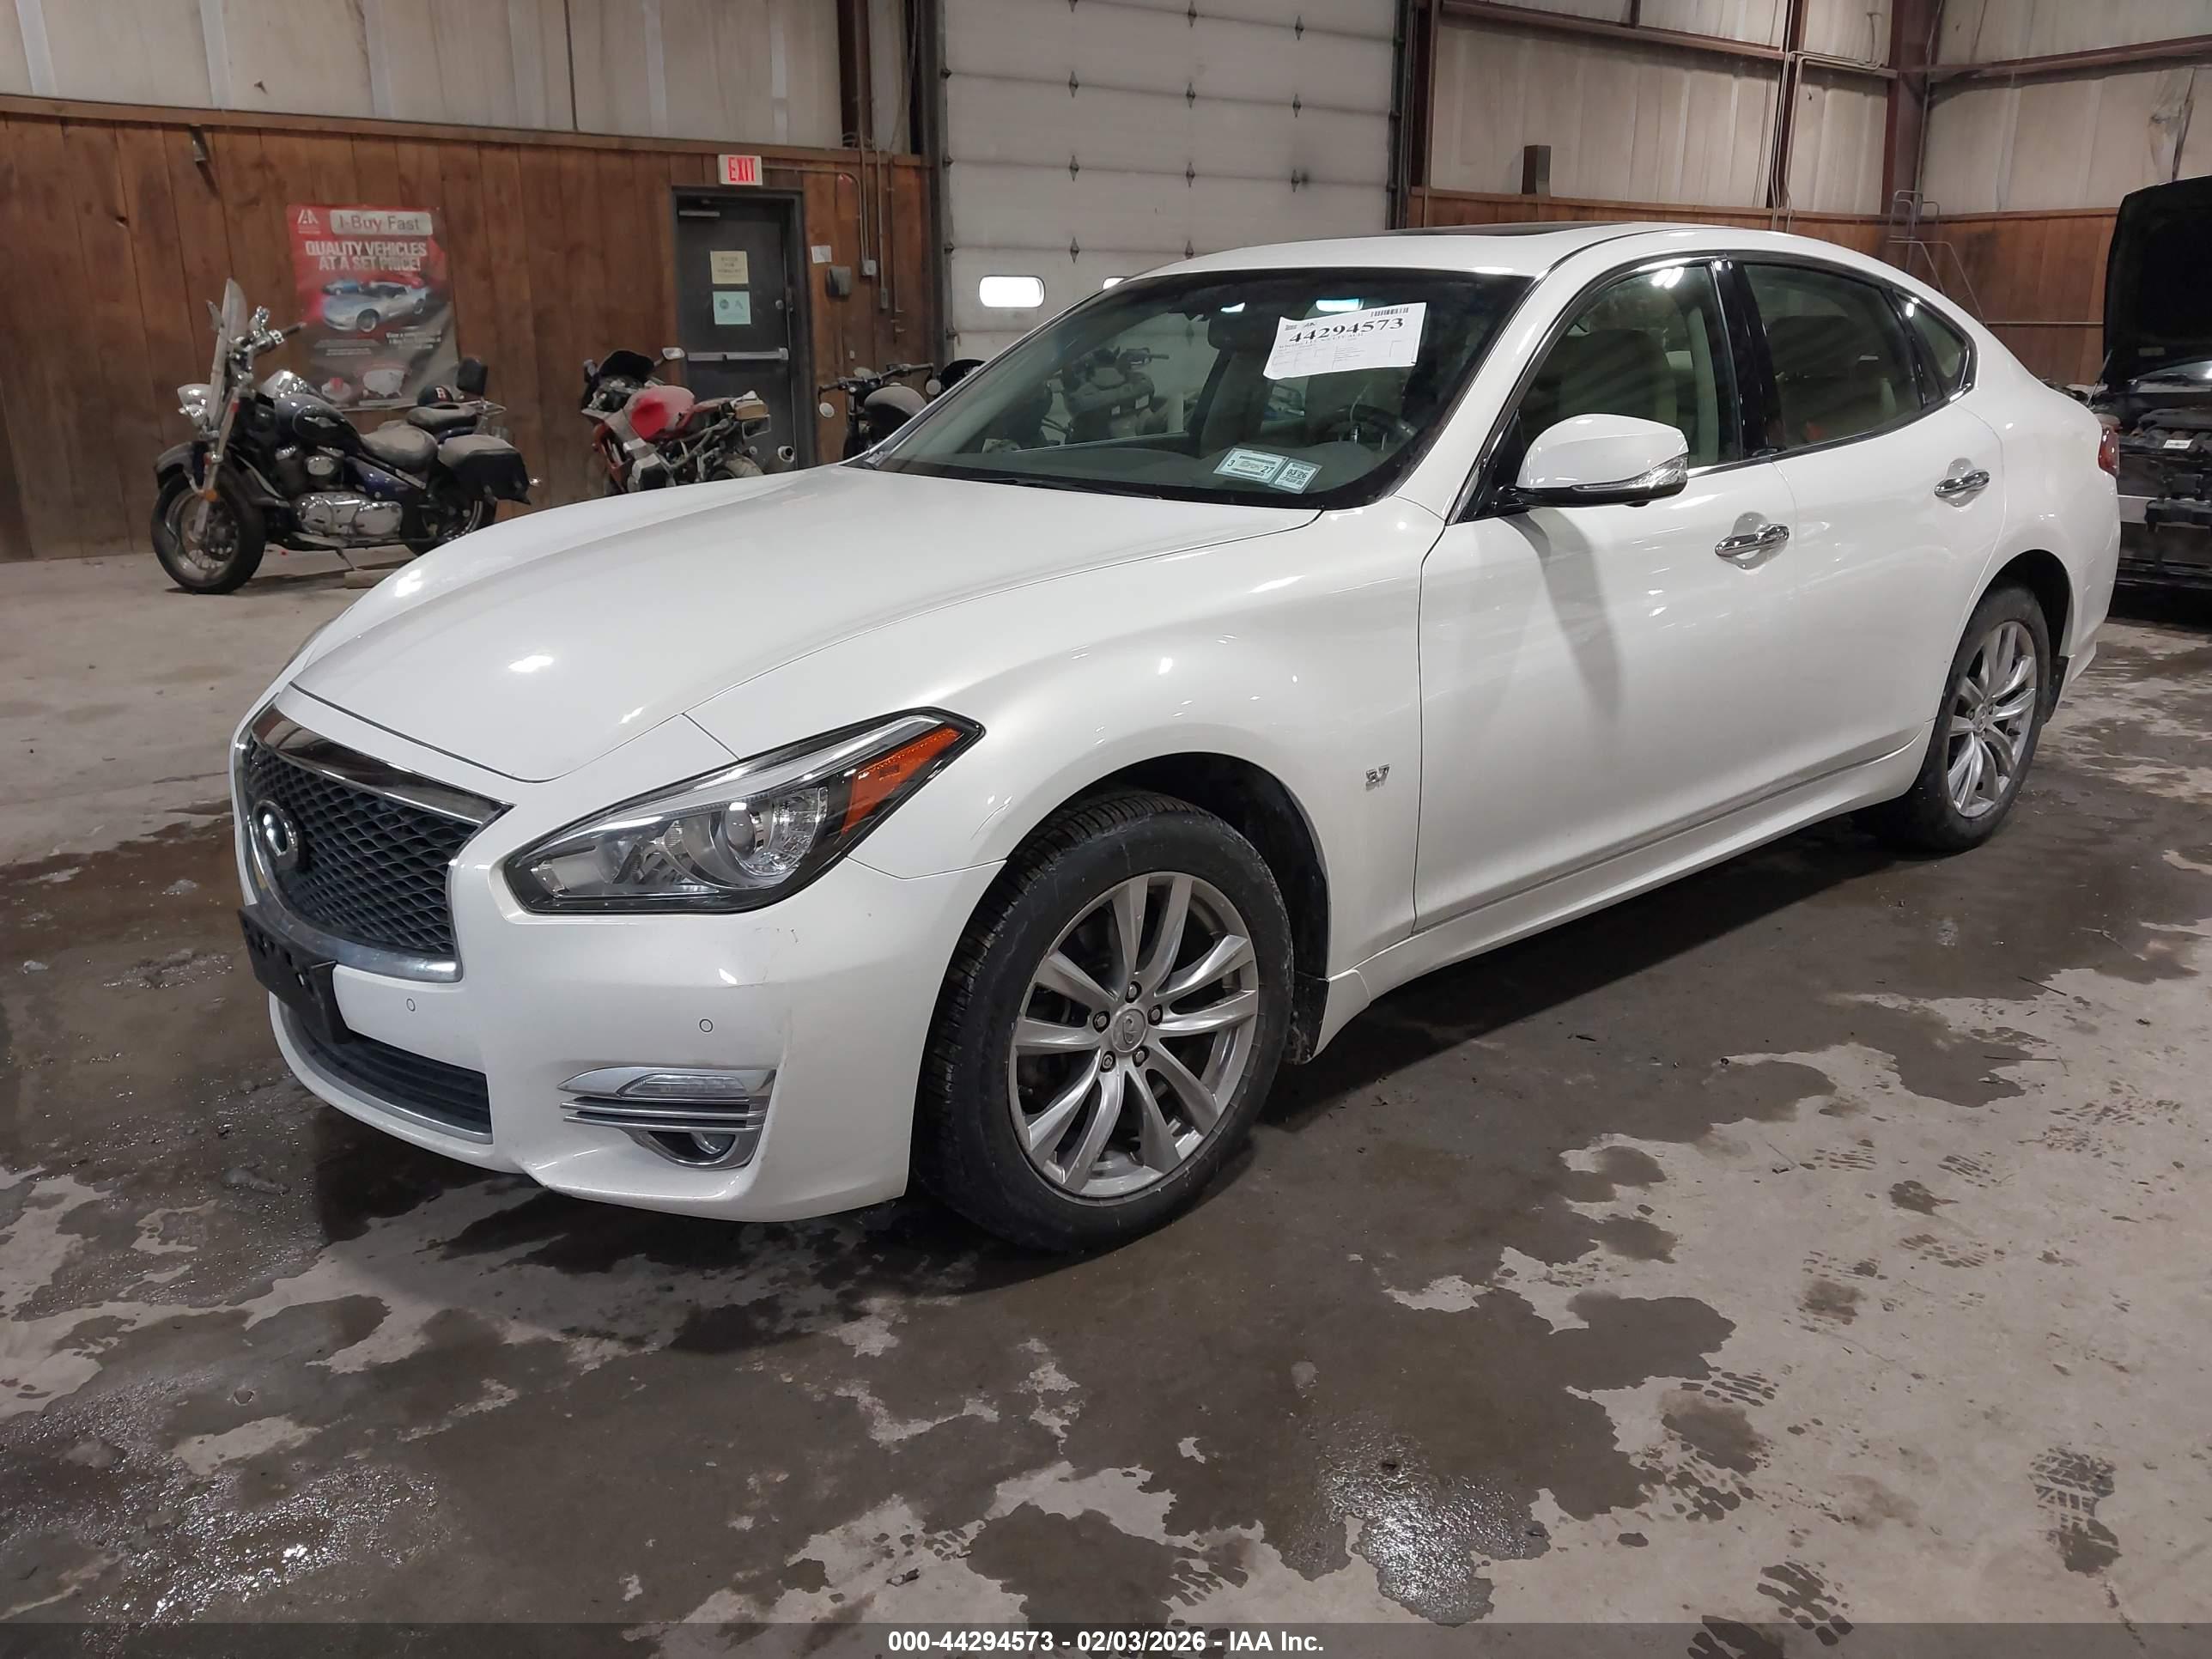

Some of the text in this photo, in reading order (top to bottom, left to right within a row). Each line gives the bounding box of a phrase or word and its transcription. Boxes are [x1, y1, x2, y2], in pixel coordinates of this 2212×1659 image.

[728, 157, 755, 181] EXIT
[339, 215, 420, 232] I-Buy Fast
[305, 240, 428, 257] QUALITY VEHICLES
[319, 257, 421, 271] AT A SET PRICE!
[1289, 318, 1405, 343] 44294573
